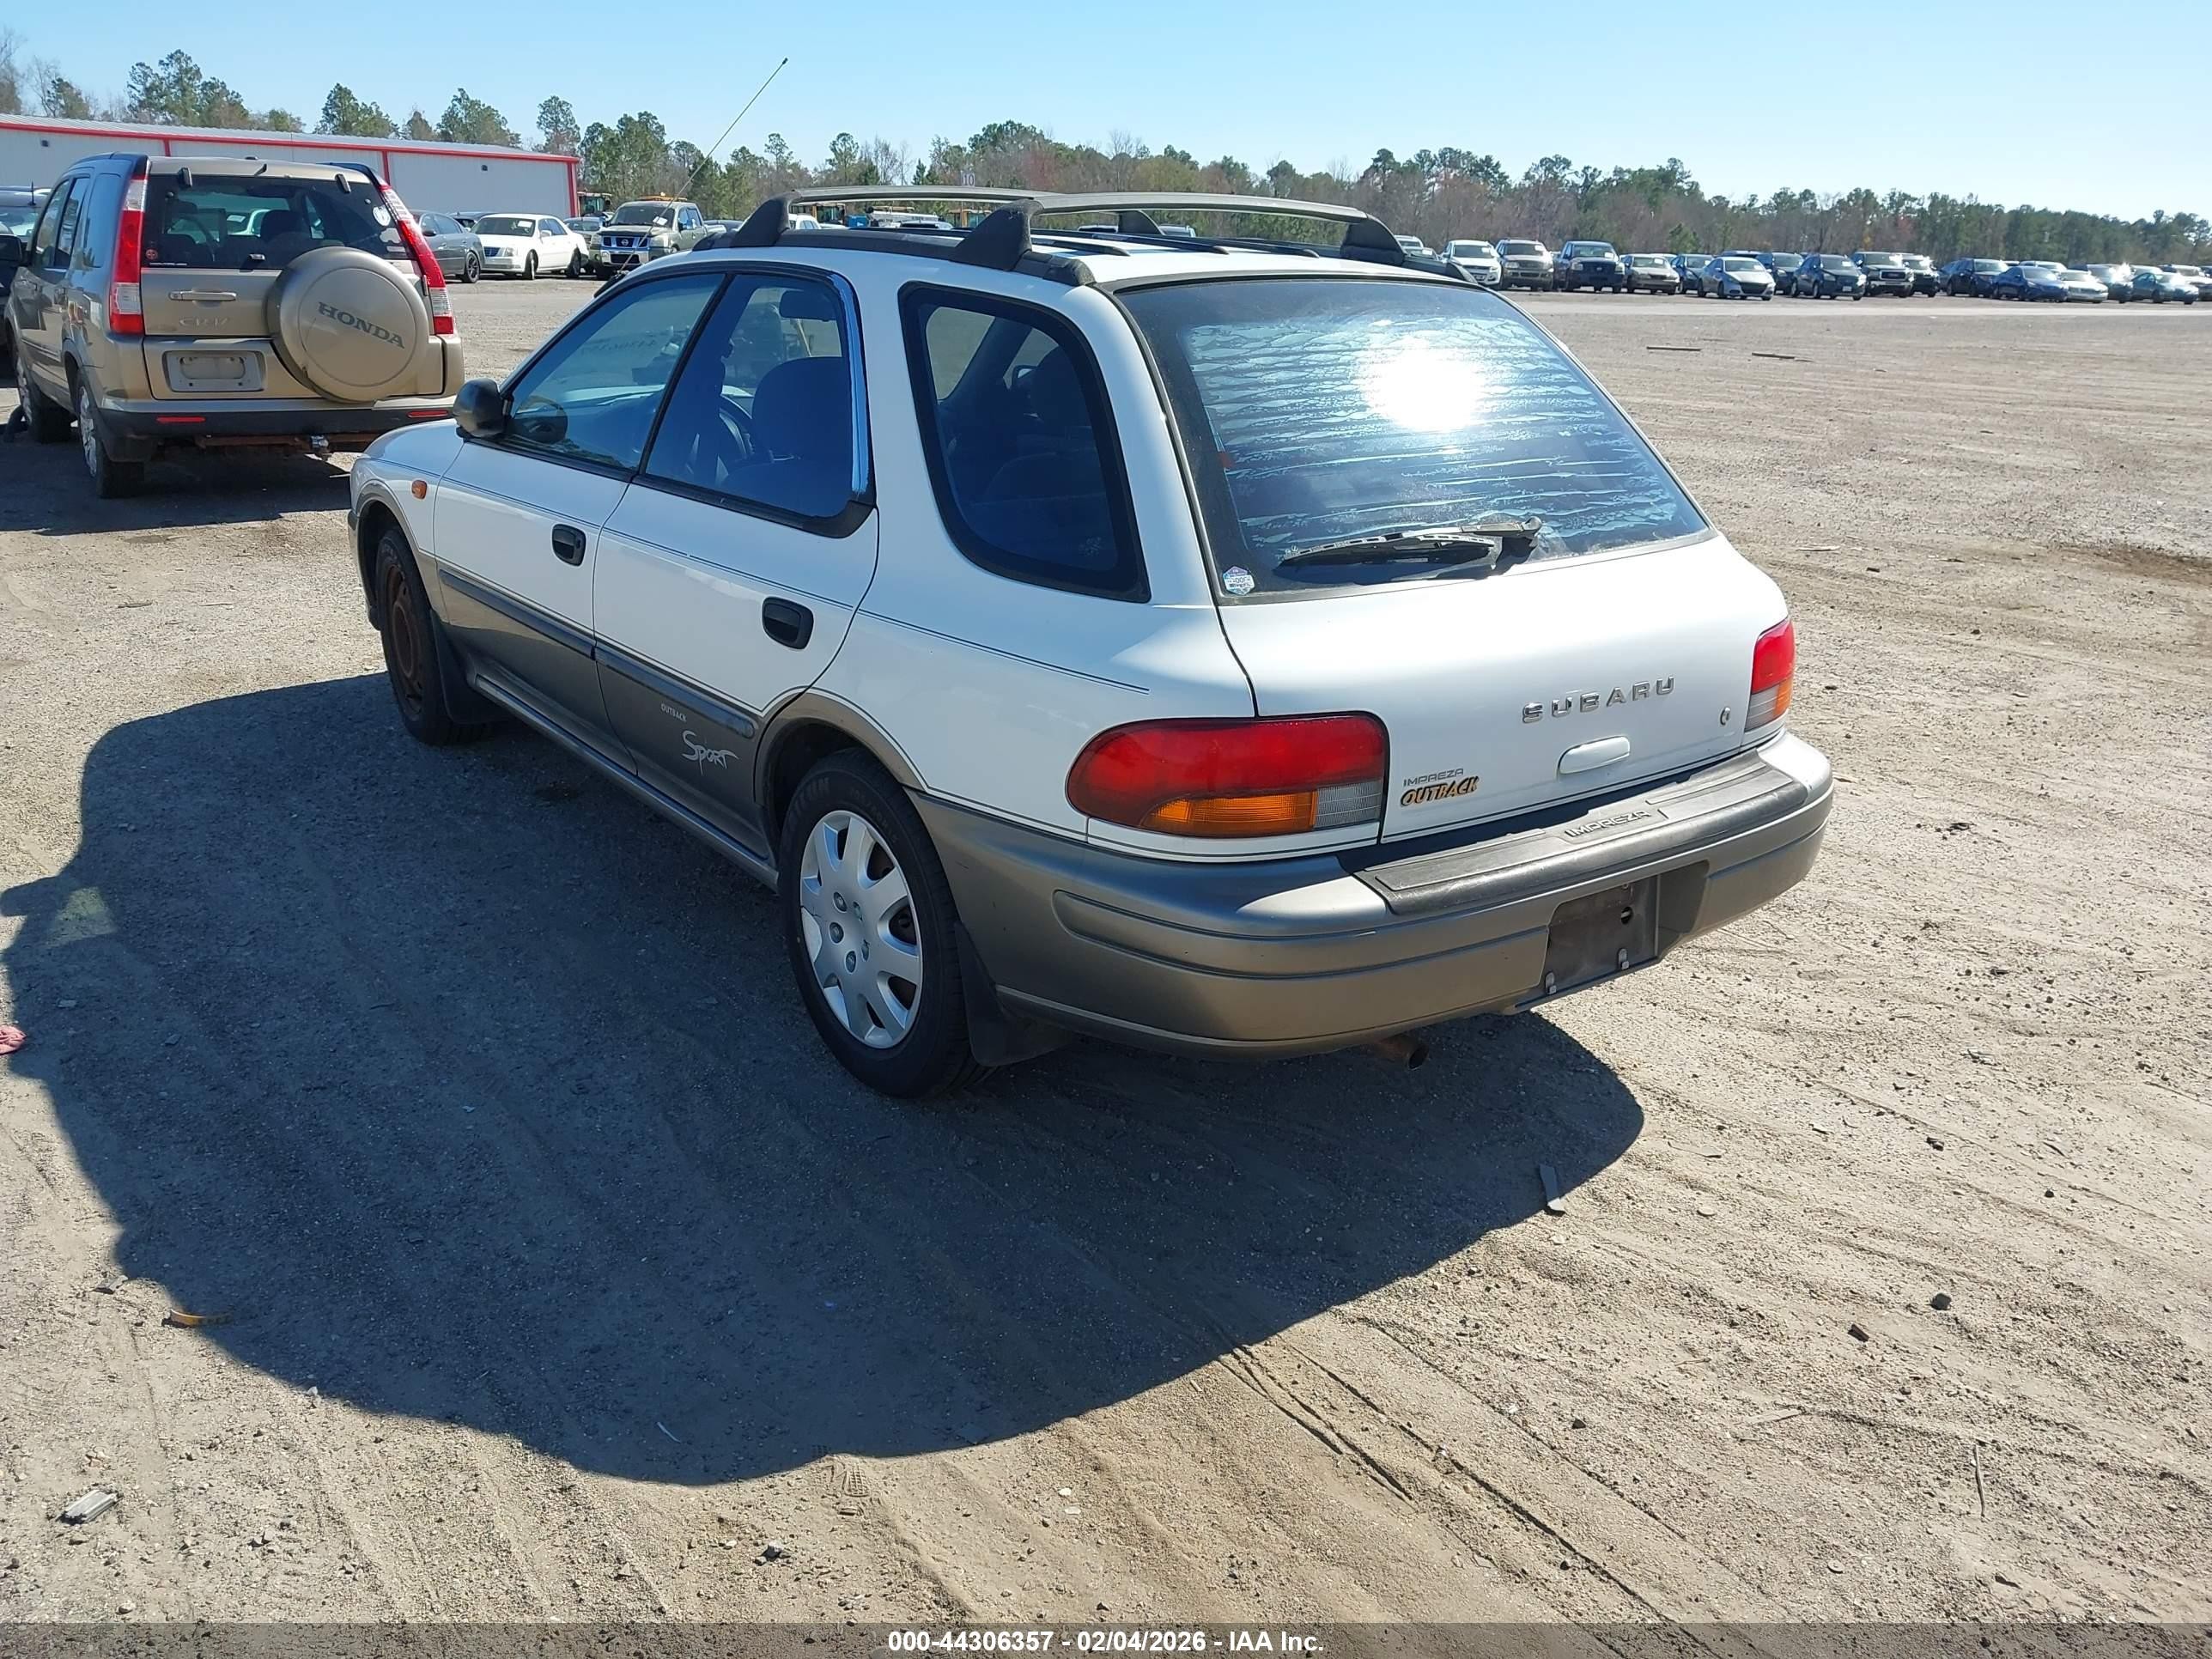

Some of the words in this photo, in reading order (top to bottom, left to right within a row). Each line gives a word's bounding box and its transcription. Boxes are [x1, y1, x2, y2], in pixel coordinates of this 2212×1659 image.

[318, 301, 405, 349] HONDA
[660, 702, 687, 722] OUTBACK
[1522, 675, 1675, 724] SUBARU
[1400, 775, 1480, 807] OUTBACK
[1403, 768, 1464, 787] IMPREZA
[1565, 810, 1652, 838] IMPREZA
